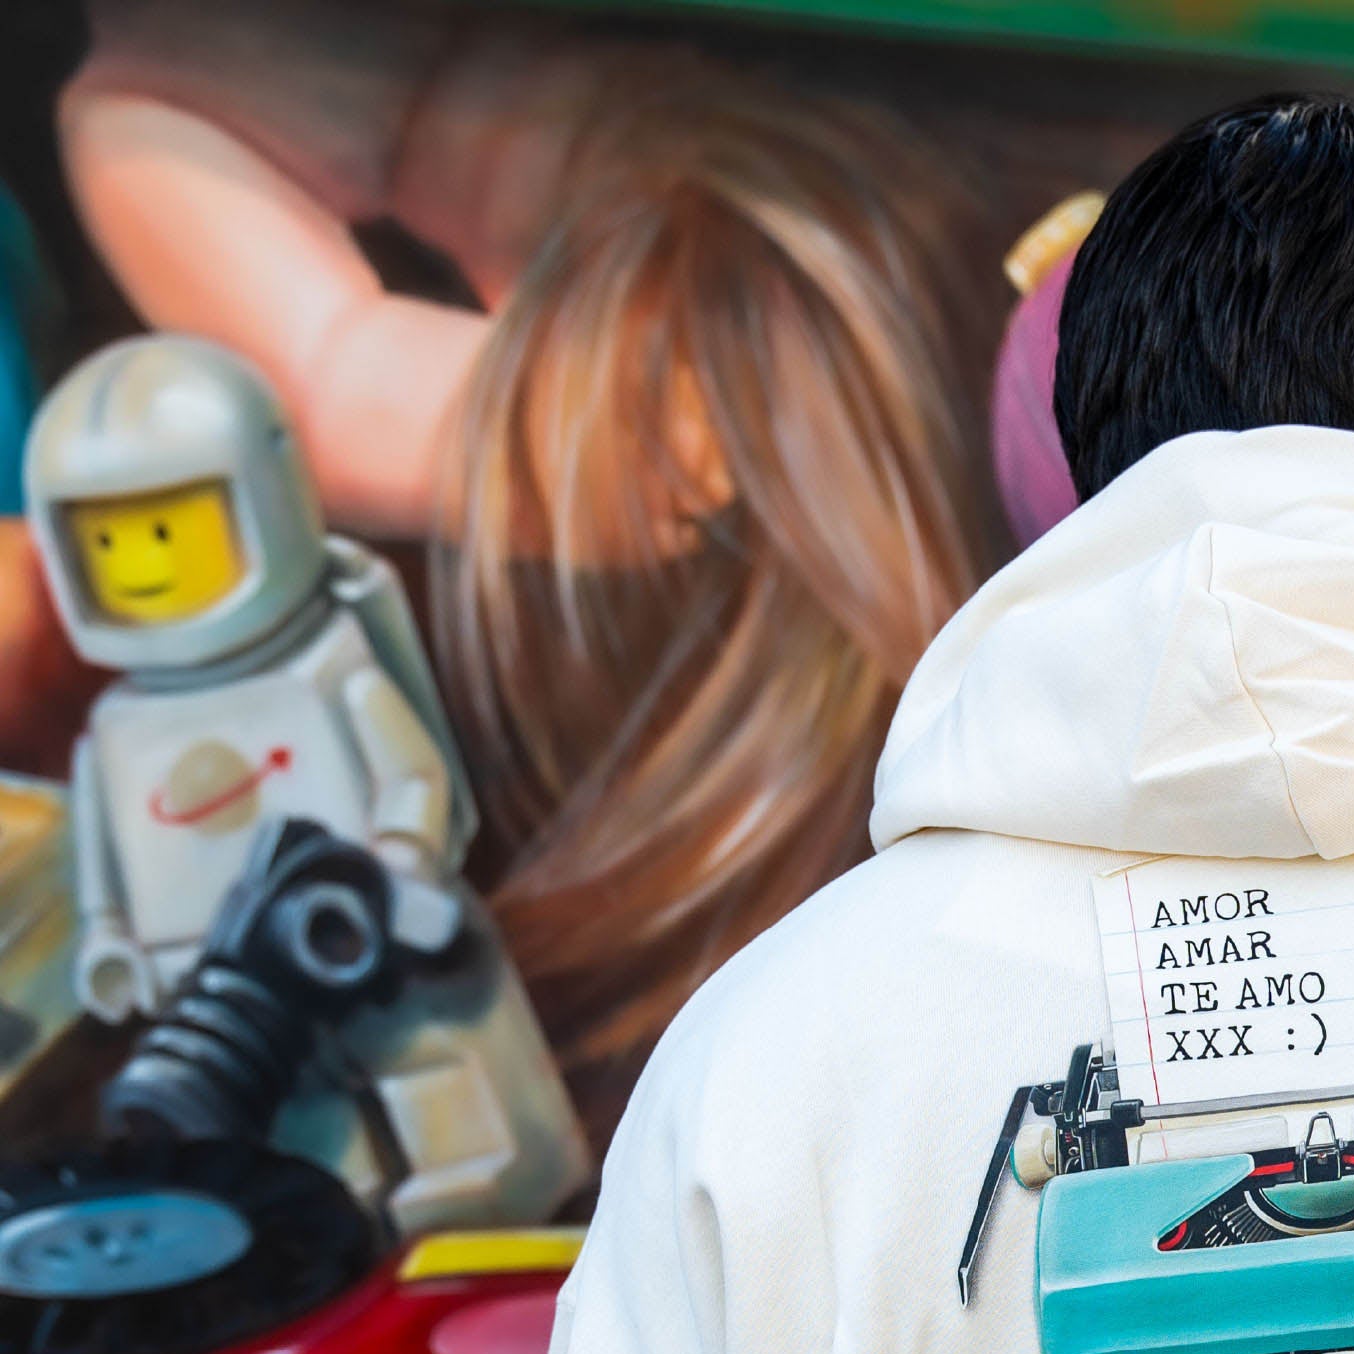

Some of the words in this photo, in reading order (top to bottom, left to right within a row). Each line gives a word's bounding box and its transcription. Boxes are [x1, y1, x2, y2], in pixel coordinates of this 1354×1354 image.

[1151, 888, 1274, 929] AMOR
[1156, 930, 1277, 970] AMAR
[1160, 981, 1219, 1015] TE
[1235, 971, 1326, 1010] AMO
[1165, 1025, 1254, 1063] XXX
